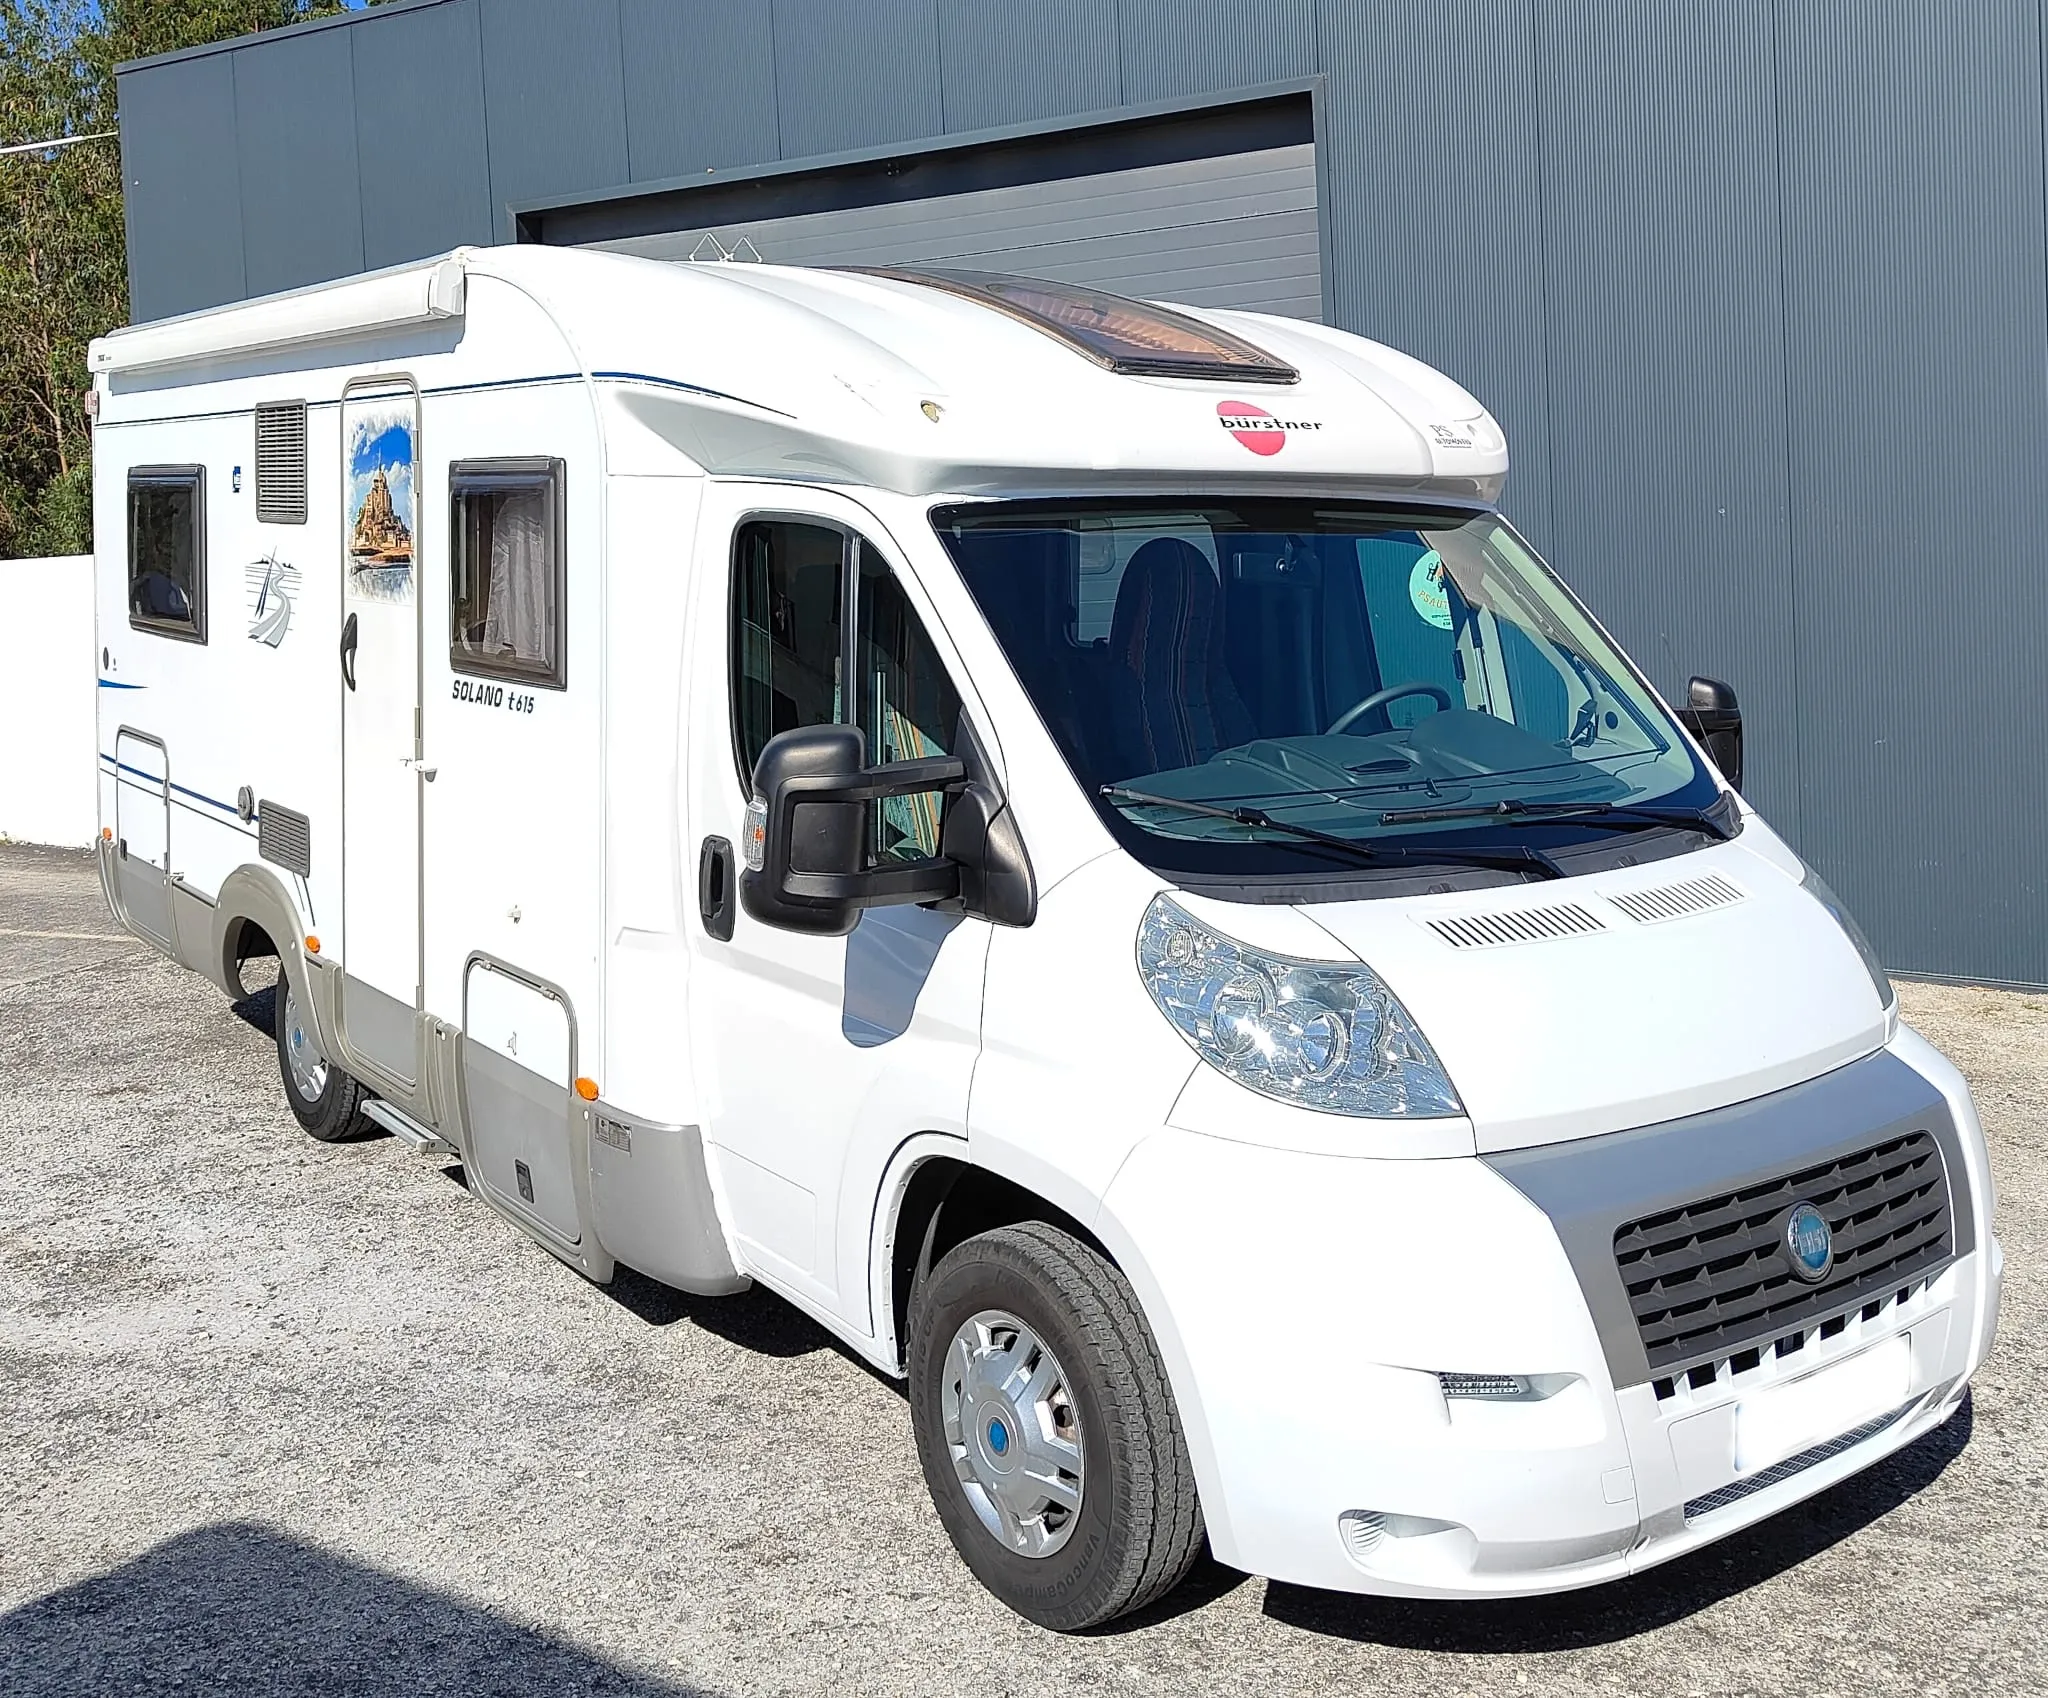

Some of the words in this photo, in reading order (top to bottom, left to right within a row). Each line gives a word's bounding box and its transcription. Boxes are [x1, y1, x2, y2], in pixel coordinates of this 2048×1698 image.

[1219, 416, 1322, 430] bürstner
[452, 680, 503, 707] SOLANO
[508, 691, 535, 714] t615
